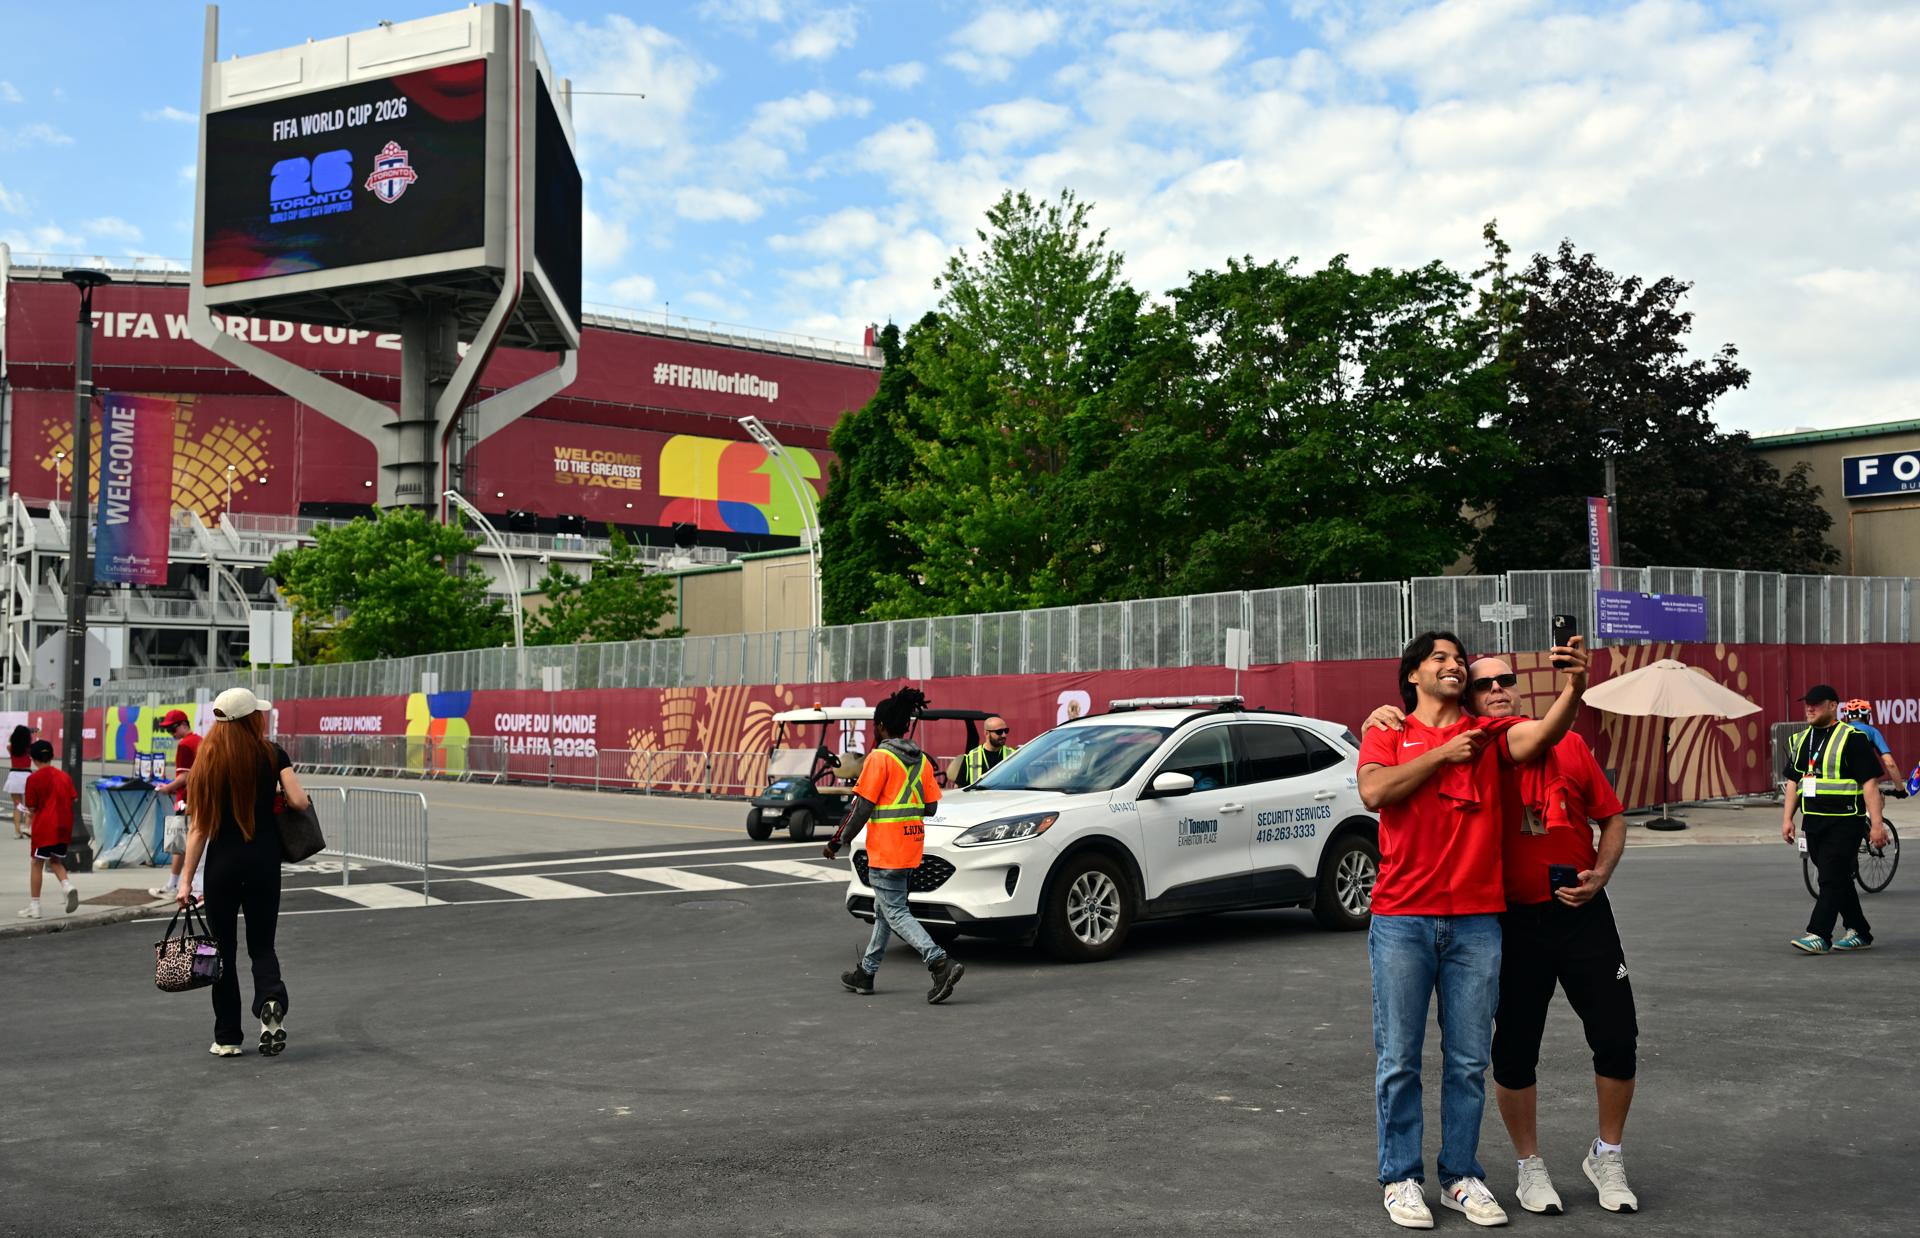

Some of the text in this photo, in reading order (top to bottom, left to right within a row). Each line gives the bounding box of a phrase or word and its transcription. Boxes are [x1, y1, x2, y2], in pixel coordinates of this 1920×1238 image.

[273, 97, 407, 141] FIFA WORLD CUP 2026
[373, 169, 409, 180] TORONTO
[270, 190, 352, 212] TORONTO
[300, 323, 370, 345] CUP
[653, 362, 778, 402] #FIFAWorldCup
[106, 406, 136, 525] WELCOME
[554, 446, 641, 465] WELCOME
[554, 459, 642, 479] TO THE GREATEST
[555, 472, 642, 490] STAGE
[319, 715, 382, 732] COUPE DU MONDE
[495, 713, 597, 733] COUPE DU MONDE
[510, 736, 526, 754] LA
[527, 737, 551, 756] FIFA
[553, 738, 597, 758] 2026
[1109, 802, 1136, 813] 041412
[1257, 805, 1331, 827] SECURITY SERVICES
[1188, 818, 1218, 834] TORONTO
[1256, 824, 1316, 843] 416-263-3333
[1178, 833, 1218, 847] EXHIBITION PLACE
